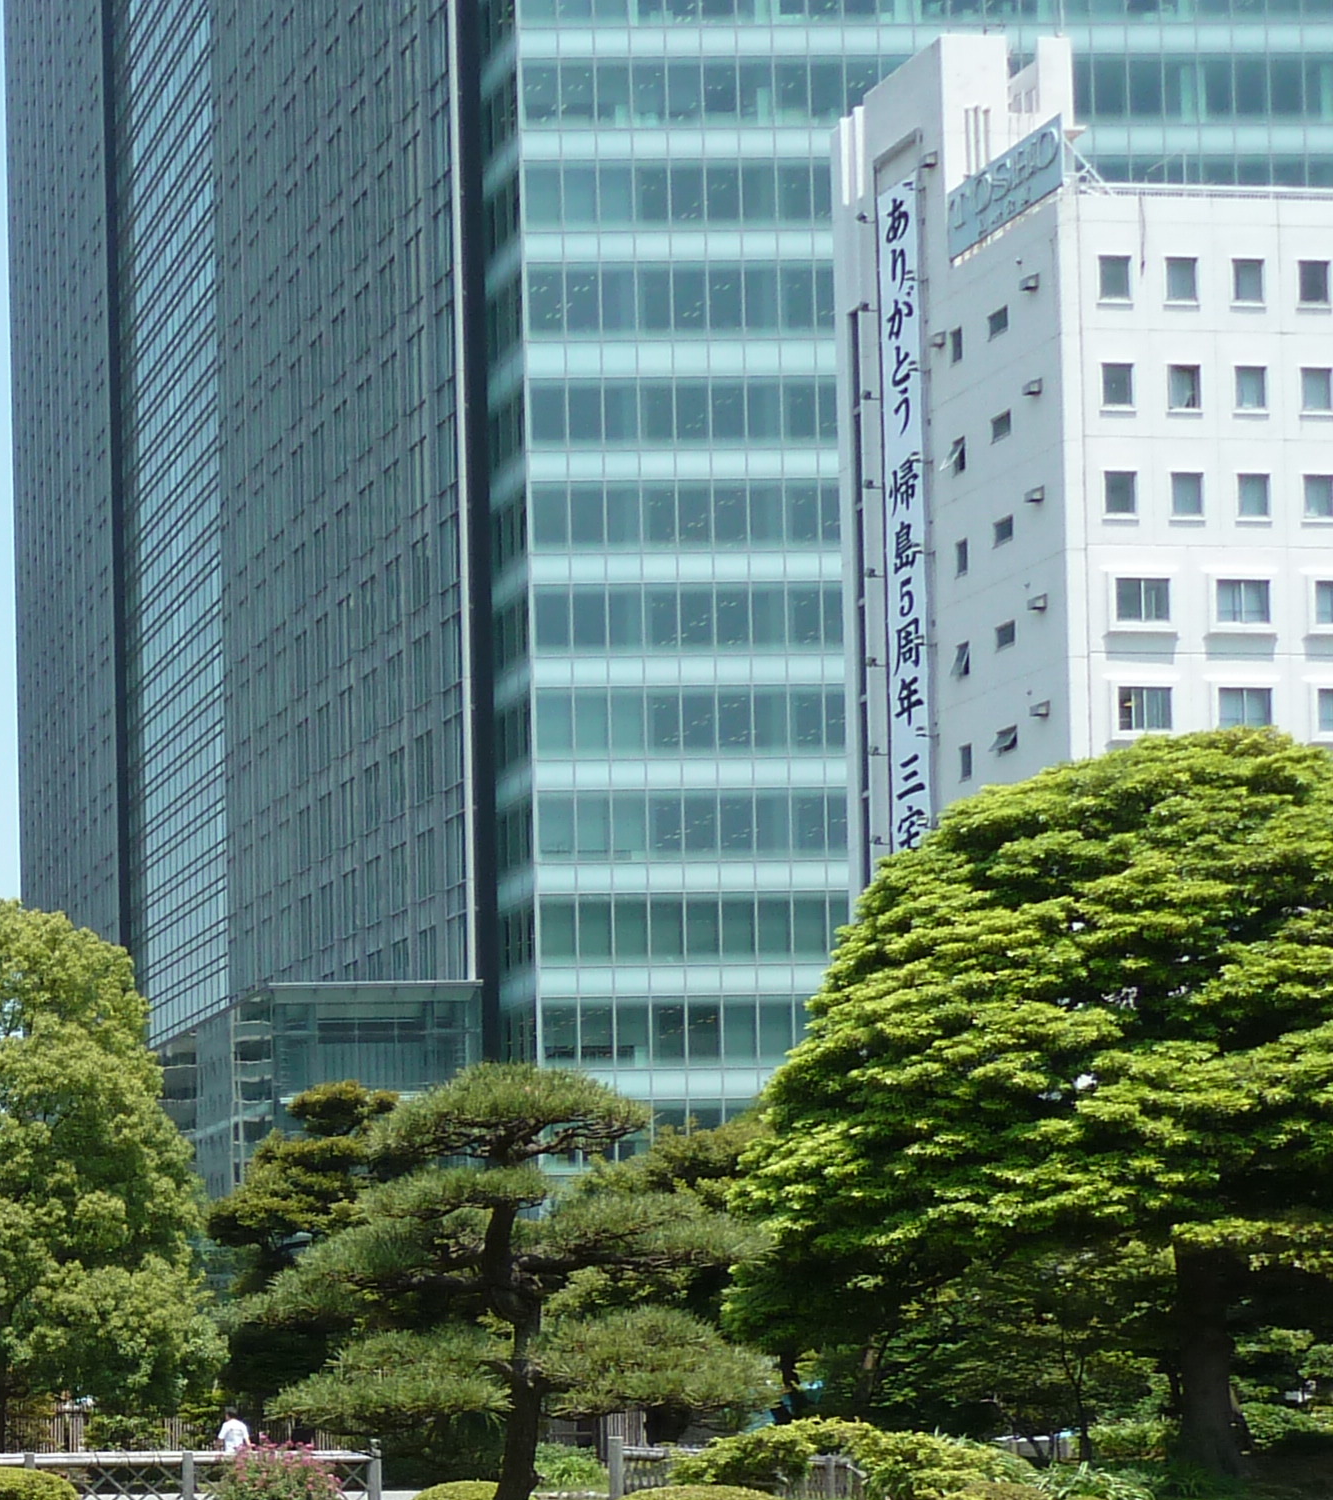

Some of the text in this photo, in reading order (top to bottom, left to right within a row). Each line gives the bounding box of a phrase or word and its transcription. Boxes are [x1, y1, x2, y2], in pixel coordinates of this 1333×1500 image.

[948, 128, 1060, 230] TOSHO
[885, 197, 914, 437] ありがとう
[889, 459, 924, 727] 帰島5周年
